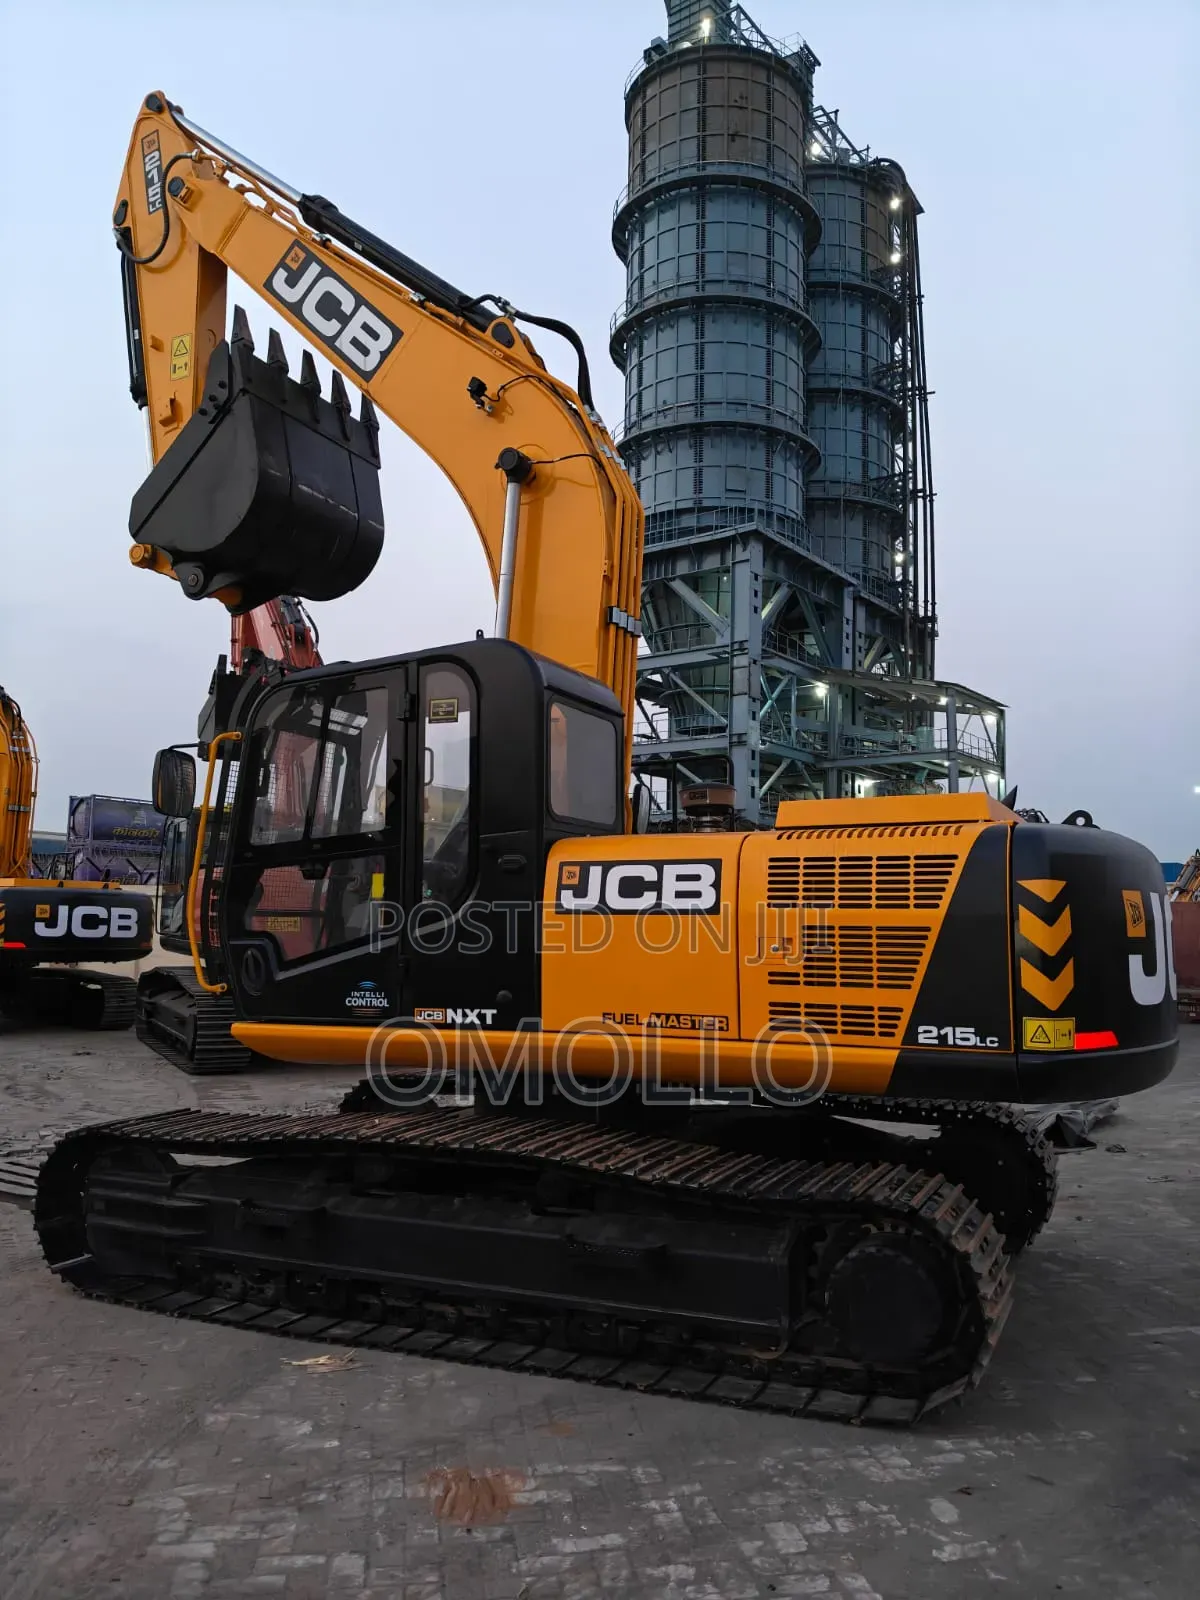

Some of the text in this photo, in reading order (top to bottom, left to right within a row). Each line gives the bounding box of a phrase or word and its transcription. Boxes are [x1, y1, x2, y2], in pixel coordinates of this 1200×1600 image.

[272, 261, 393, 372] JCB
[561, 864, 716, 910] JCB
[34, 904, 138, 938] JCB
[345, 997, 389, 1007] CONTROL
[416, 1008, 497, 1024] JCB NXT
[602, 1012, 728, 1031] FUEL MASTER
